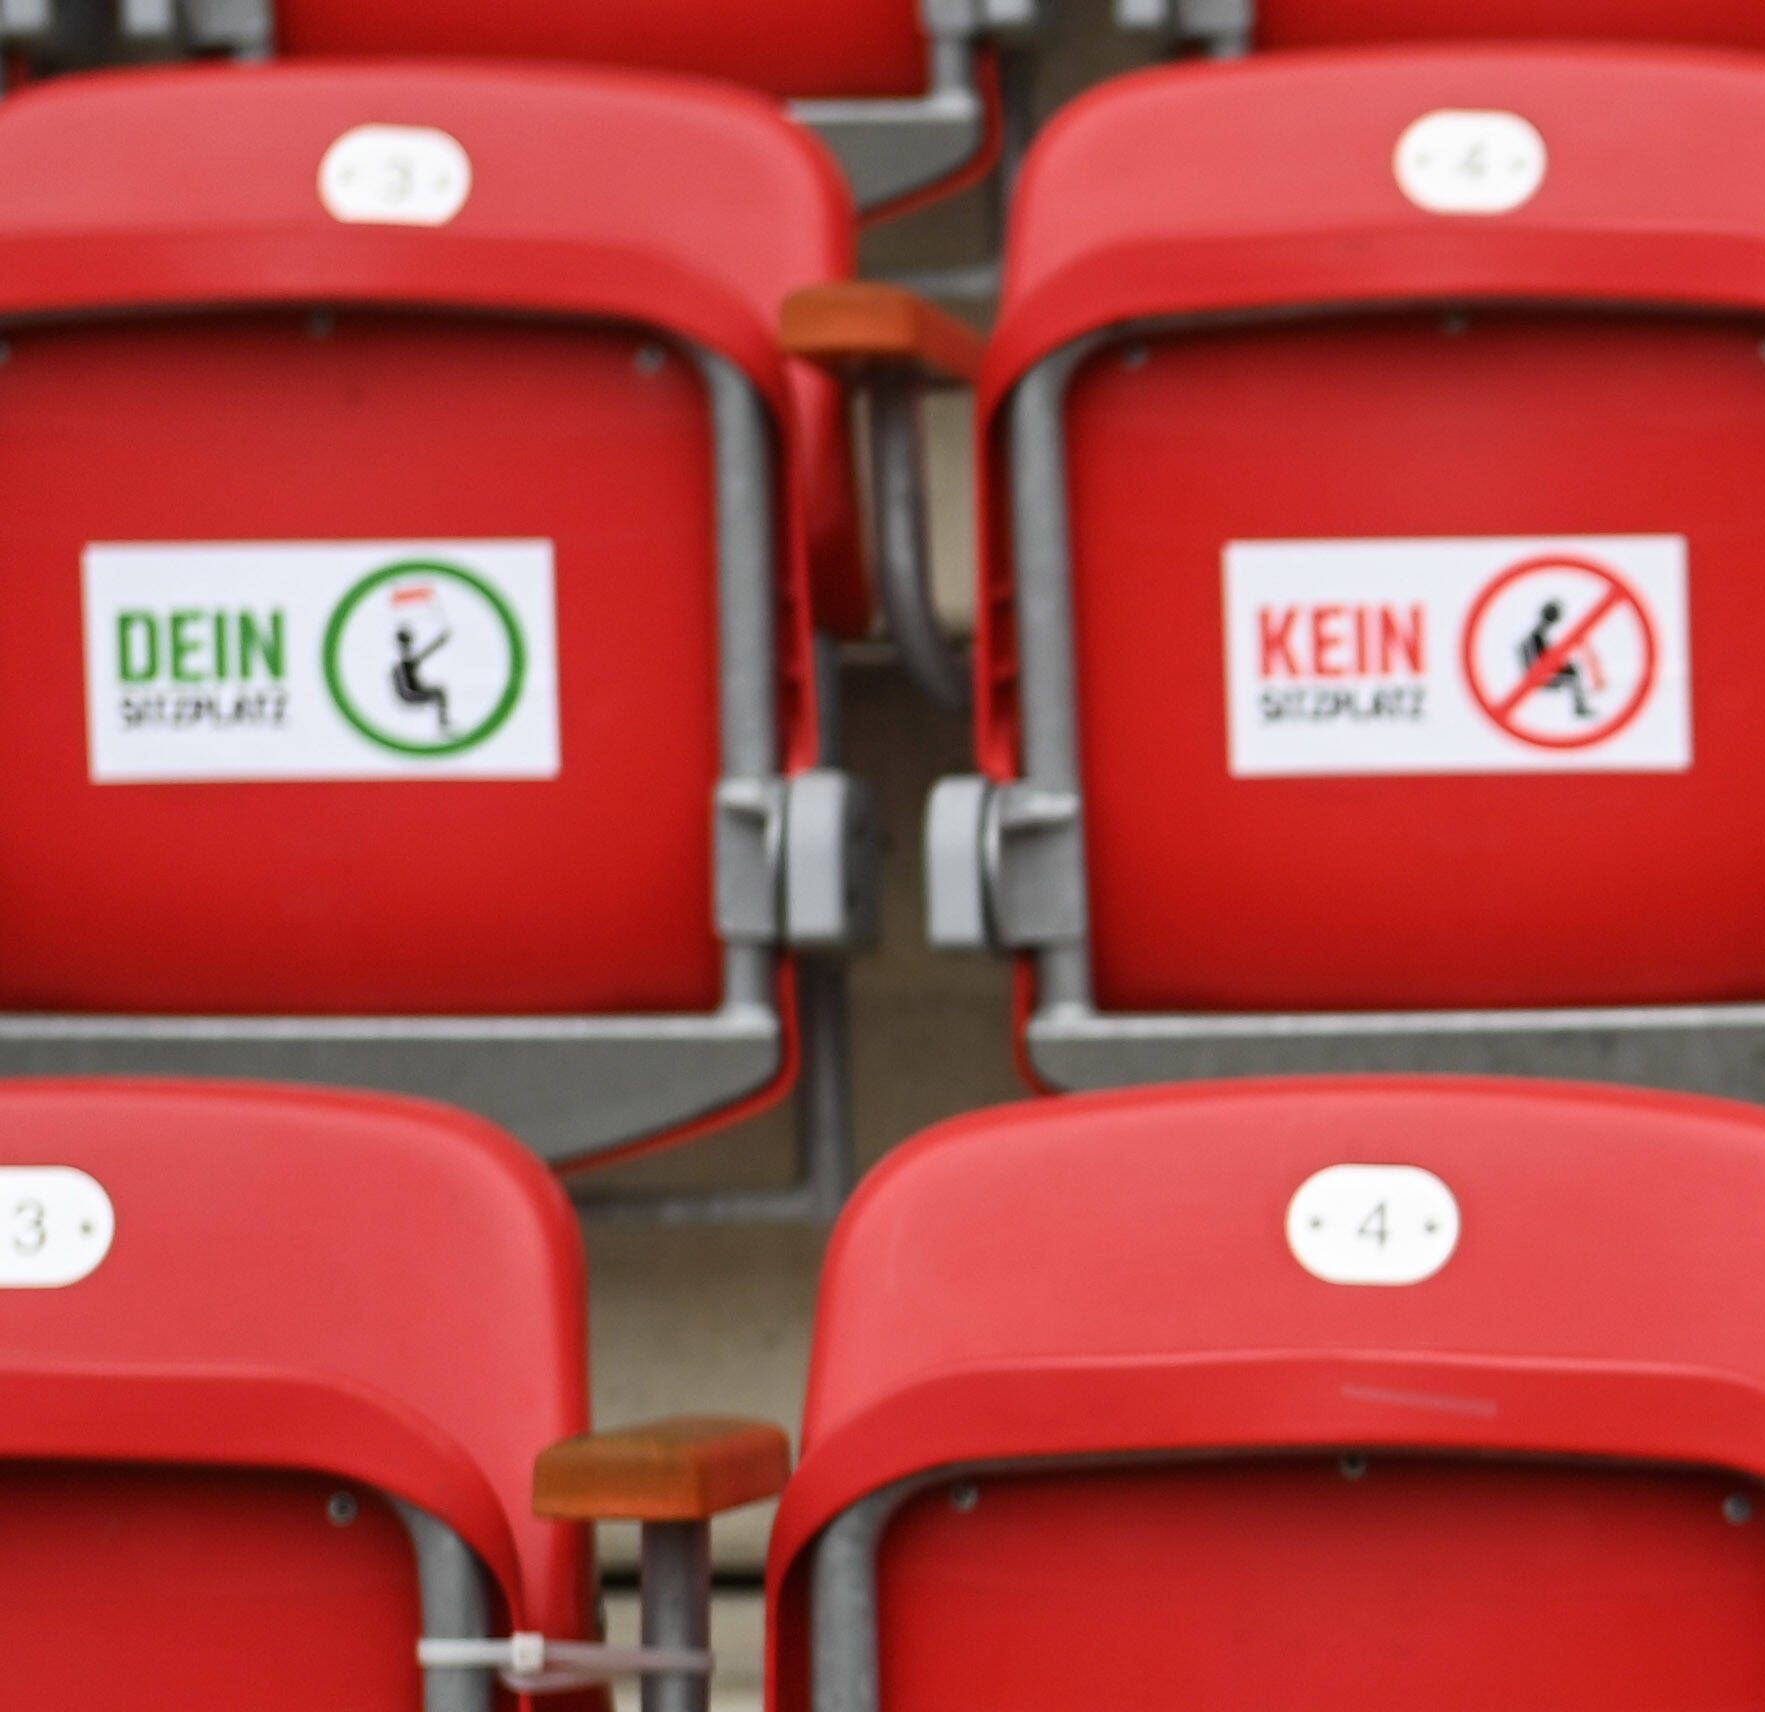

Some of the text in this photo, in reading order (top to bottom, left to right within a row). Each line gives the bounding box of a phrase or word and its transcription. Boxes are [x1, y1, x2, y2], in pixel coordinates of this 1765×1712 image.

[117, 609, 287, 684] DEIN
[1258, 604, 1426, 678] KEIN
[13, 1198, 46, 1257] 3
[1356, 1199, 1390, 1247] 4
